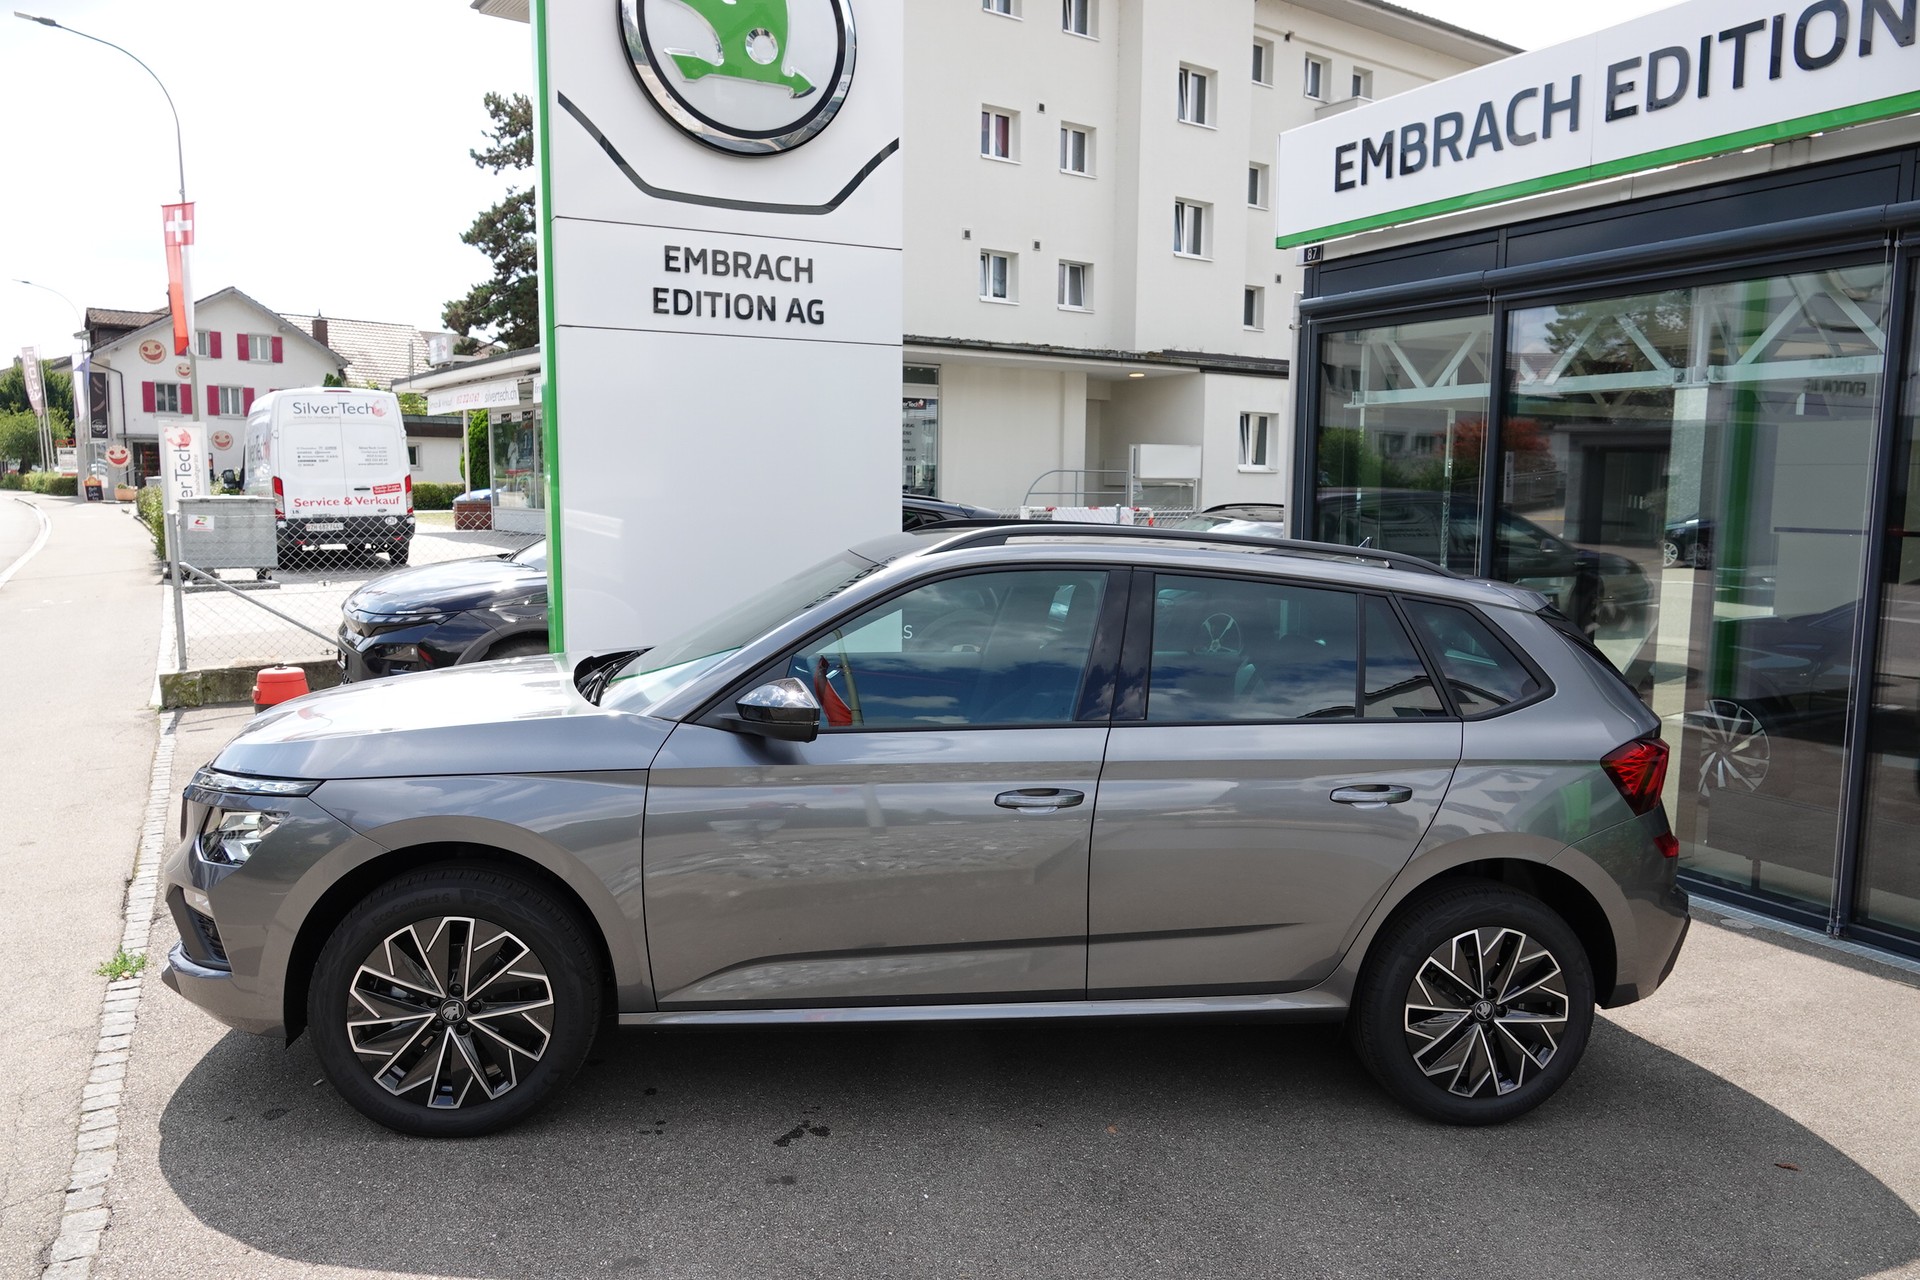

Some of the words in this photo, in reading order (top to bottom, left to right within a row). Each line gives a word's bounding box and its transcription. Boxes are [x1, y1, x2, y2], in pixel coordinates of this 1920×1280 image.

[1335, 73, 1582, 193] EMBRACH
[1606, 0, 1917, 123] EDITION
[664, 245, 813, 284] EMBRACH
[1307, 247, 1318, 261] 87
[653, 287, 777, 322] EDITION
[785, 299, 825, 325] AG
[293, 402, 375, 415] SilverTech
[294, 497, 340, 508] Service
[344, 496, 352, 505] &
[355, 496, 400, 506] Verkauf
[371, 894, 440, 926] EcoContact
[442, 893, 450, 903] 6
